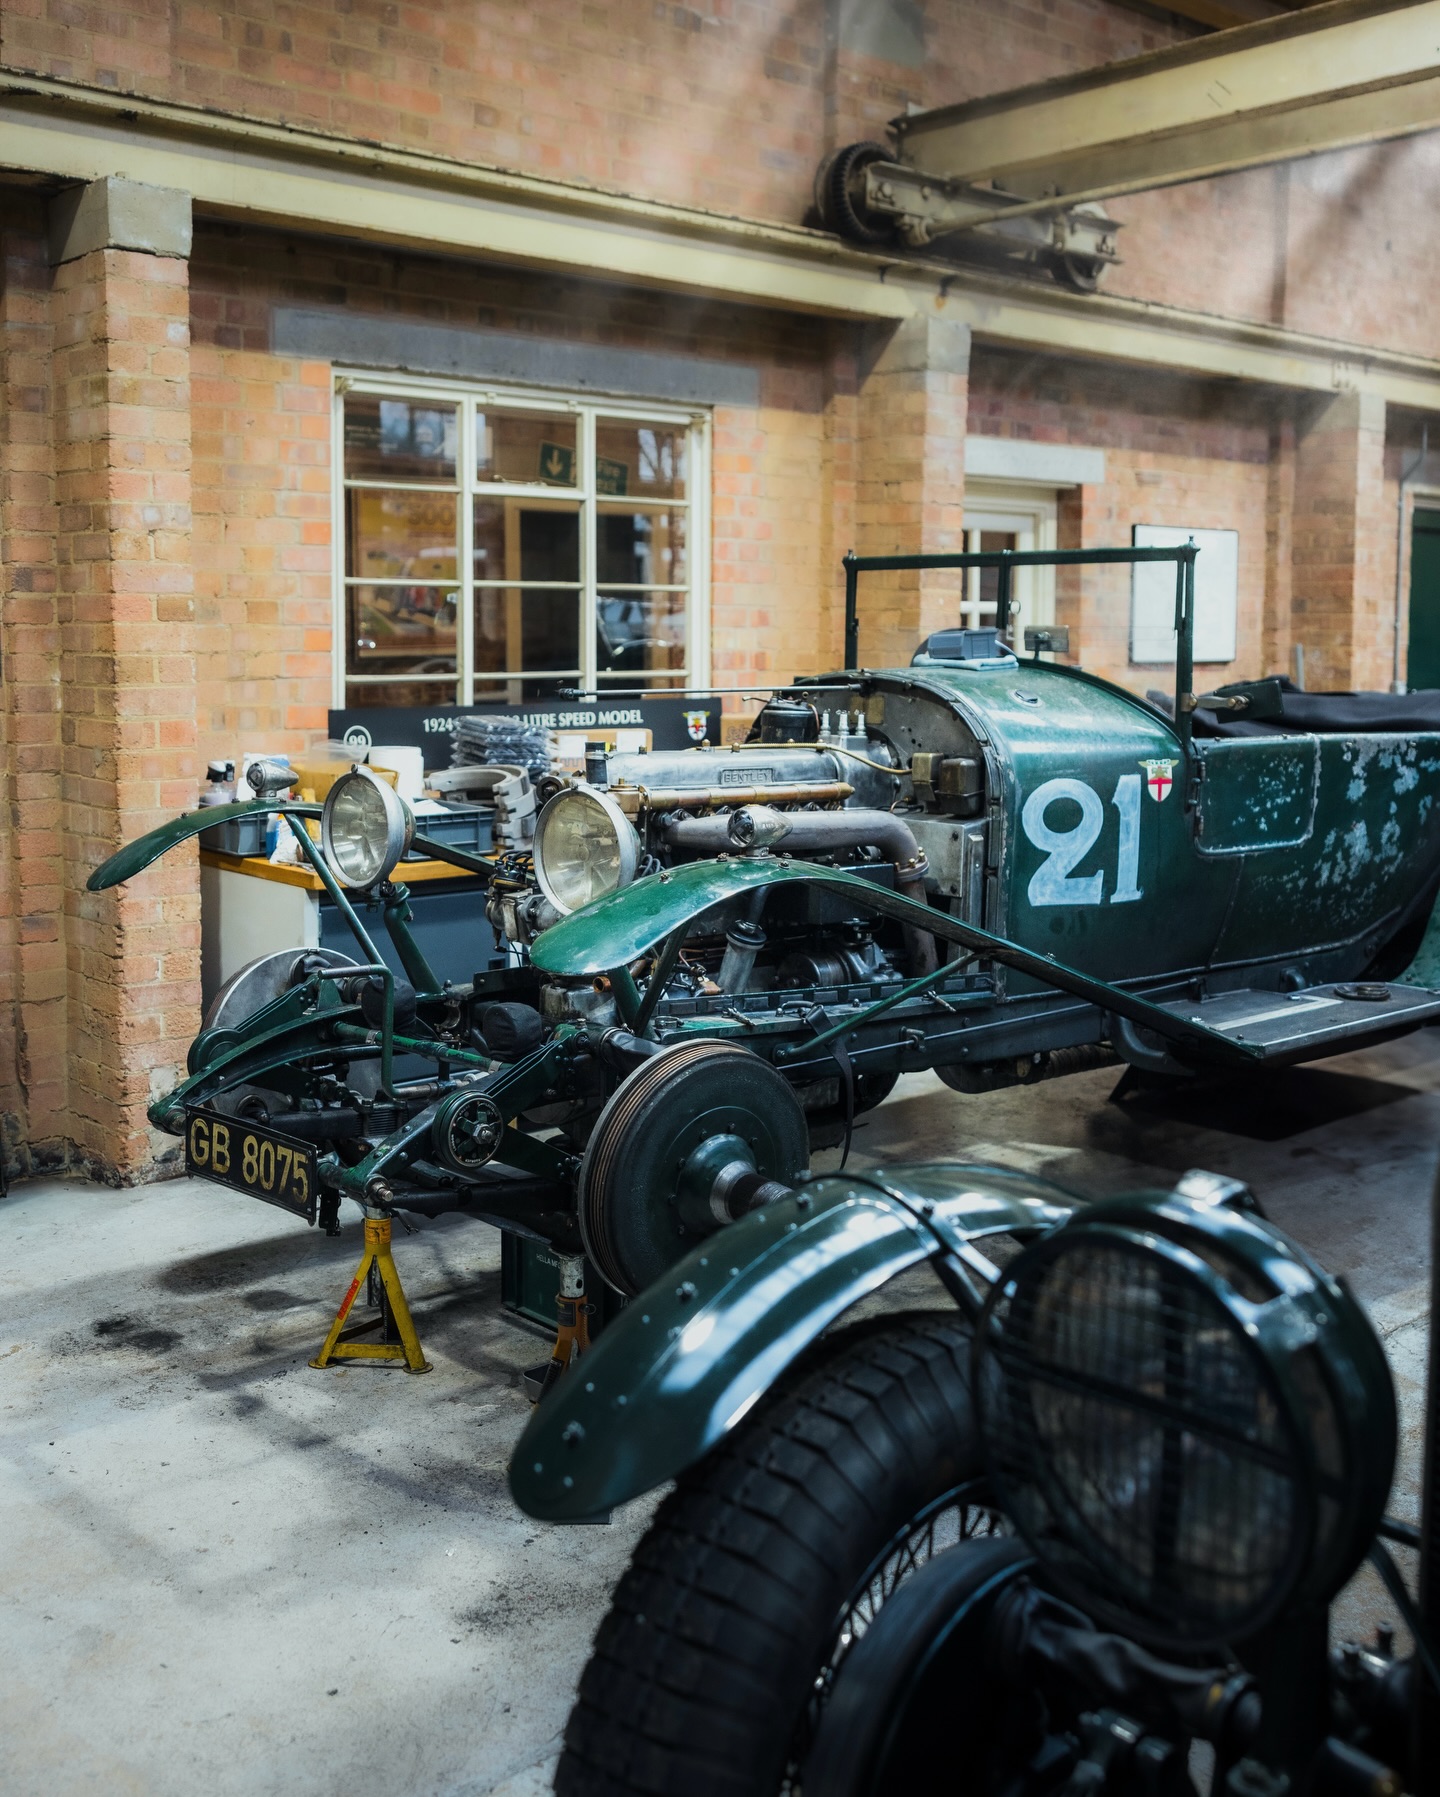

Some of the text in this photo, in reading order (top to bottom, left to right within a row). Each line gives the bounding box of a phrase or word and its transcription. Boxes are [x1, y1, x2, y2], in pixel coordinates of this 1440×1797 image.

[422, 717, 453, 733] 1924
[558, 711, 597, 727] SPEED
[598, 709, 644, 725] MODEL
[723, 772, 769, 783] BENTLEY
[1021, 773, 1145, 907] 21
[190, 1117, 309, 1204] GB 8075
